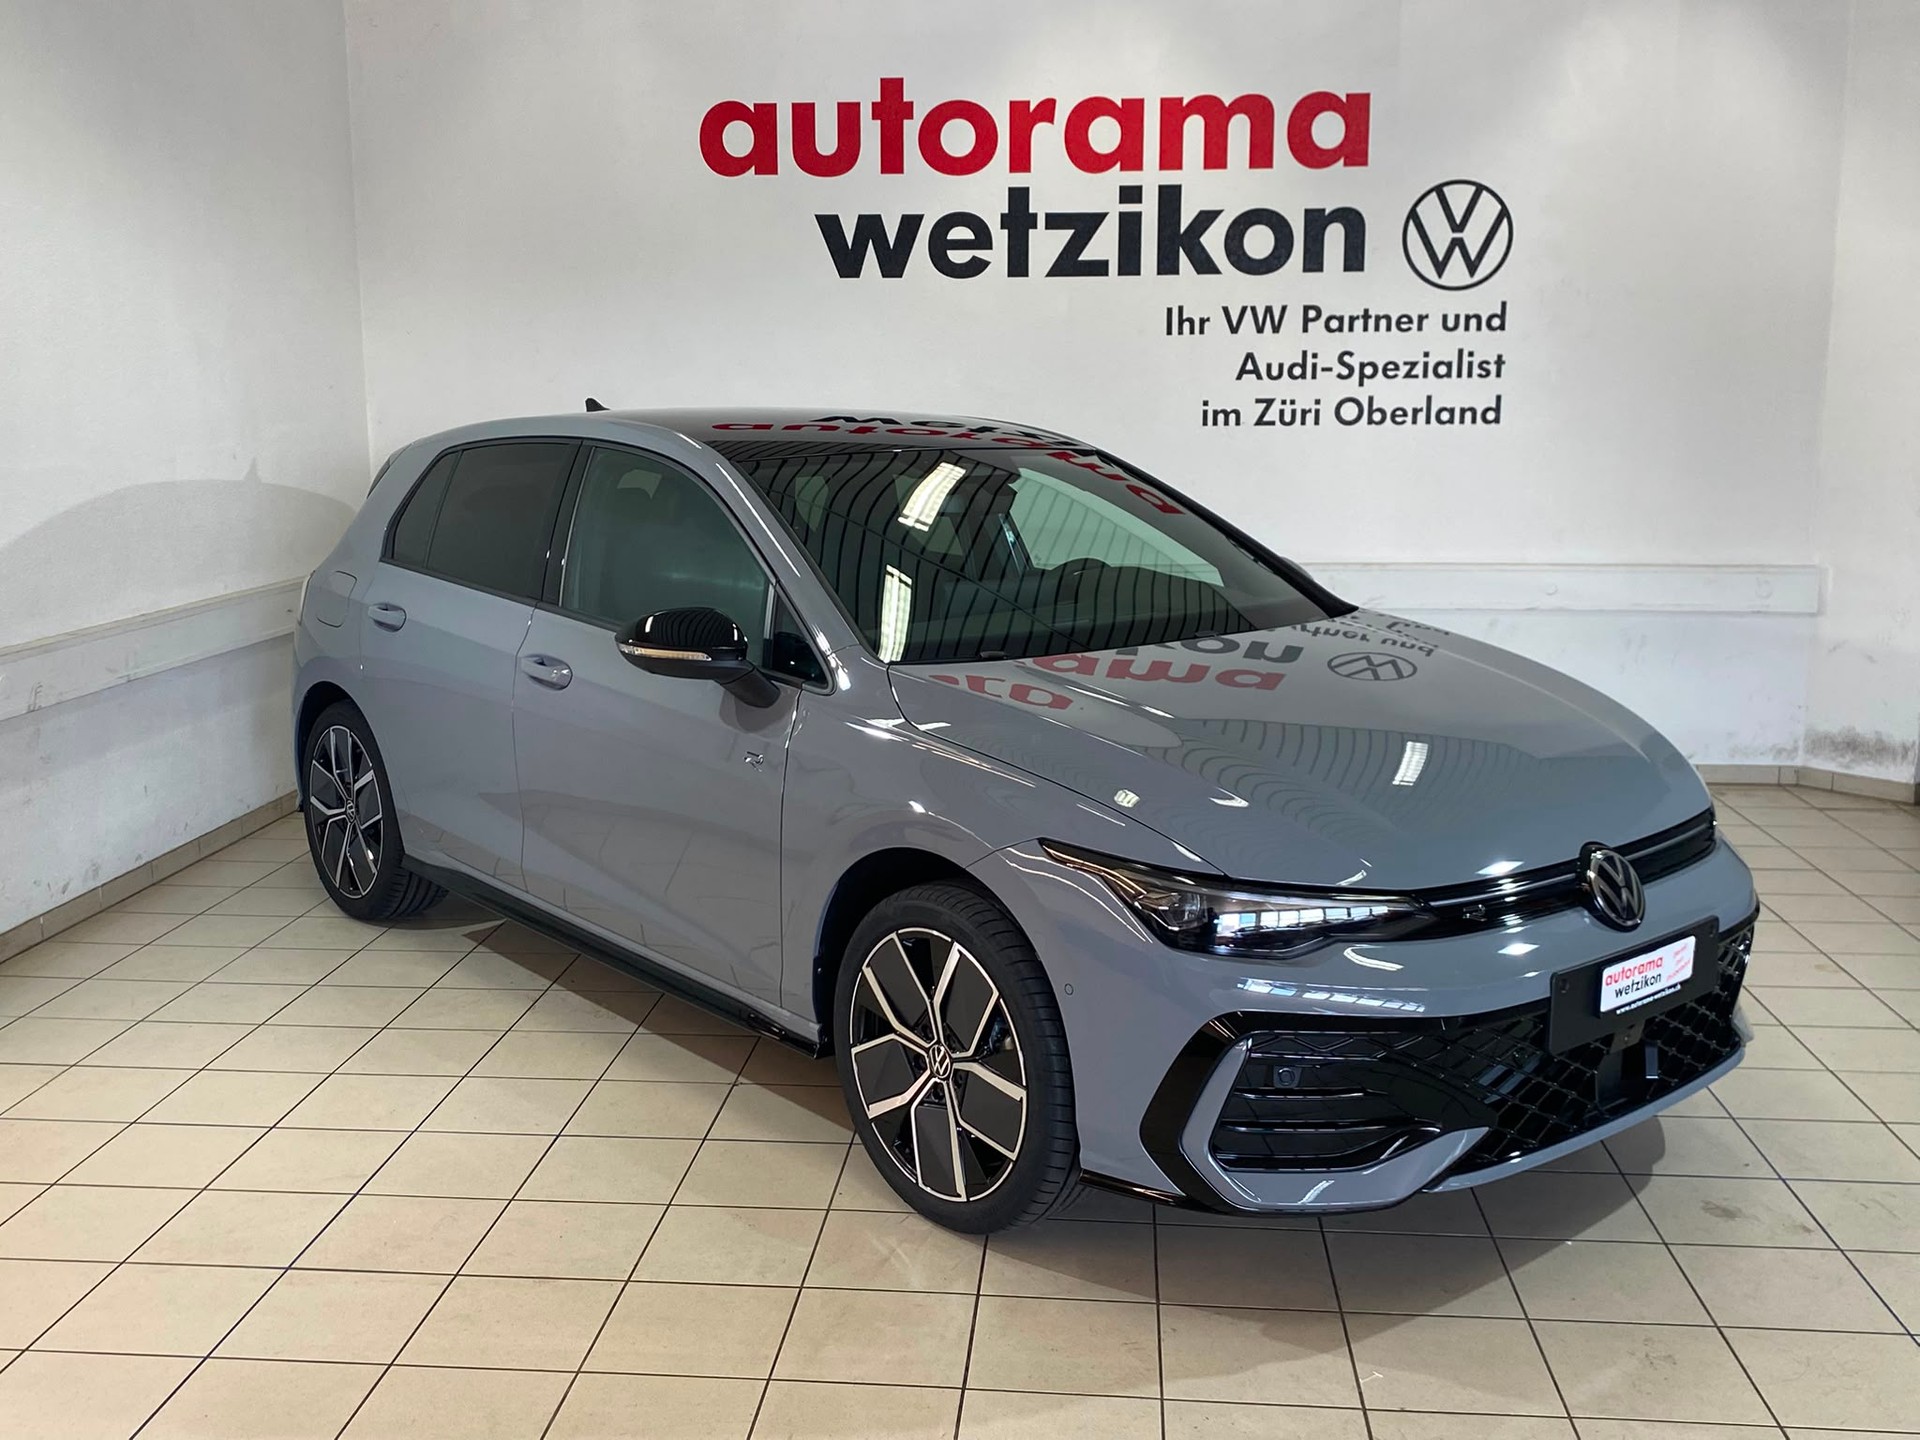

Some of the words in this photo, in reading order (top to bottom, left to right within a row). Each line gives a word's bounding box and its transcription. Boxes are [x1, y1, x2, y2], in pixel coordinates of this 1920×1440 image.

[699, 77, 1371, 177] autorama
[814, 184, 1366, 280] wetzikon
[1401, 179, 1514, 291] VW
[1166, 305, 1211, 336] Ihr
[1221, 304, 1288, 335] VW
[1302, 304, 1429, 334] Partner
[1441, 300, 1507, 332] und
[1235, 349, 1506, 387] Audi-Spezialist
[1202, 399, 1241, 427] im
[1253, 397, 1321, 427] Züri
[1334, 395, 1502, 426] Oberland
[1604, 956, 1664, 987] autorama
[1614, 972, 1662, 998] wetzikon
